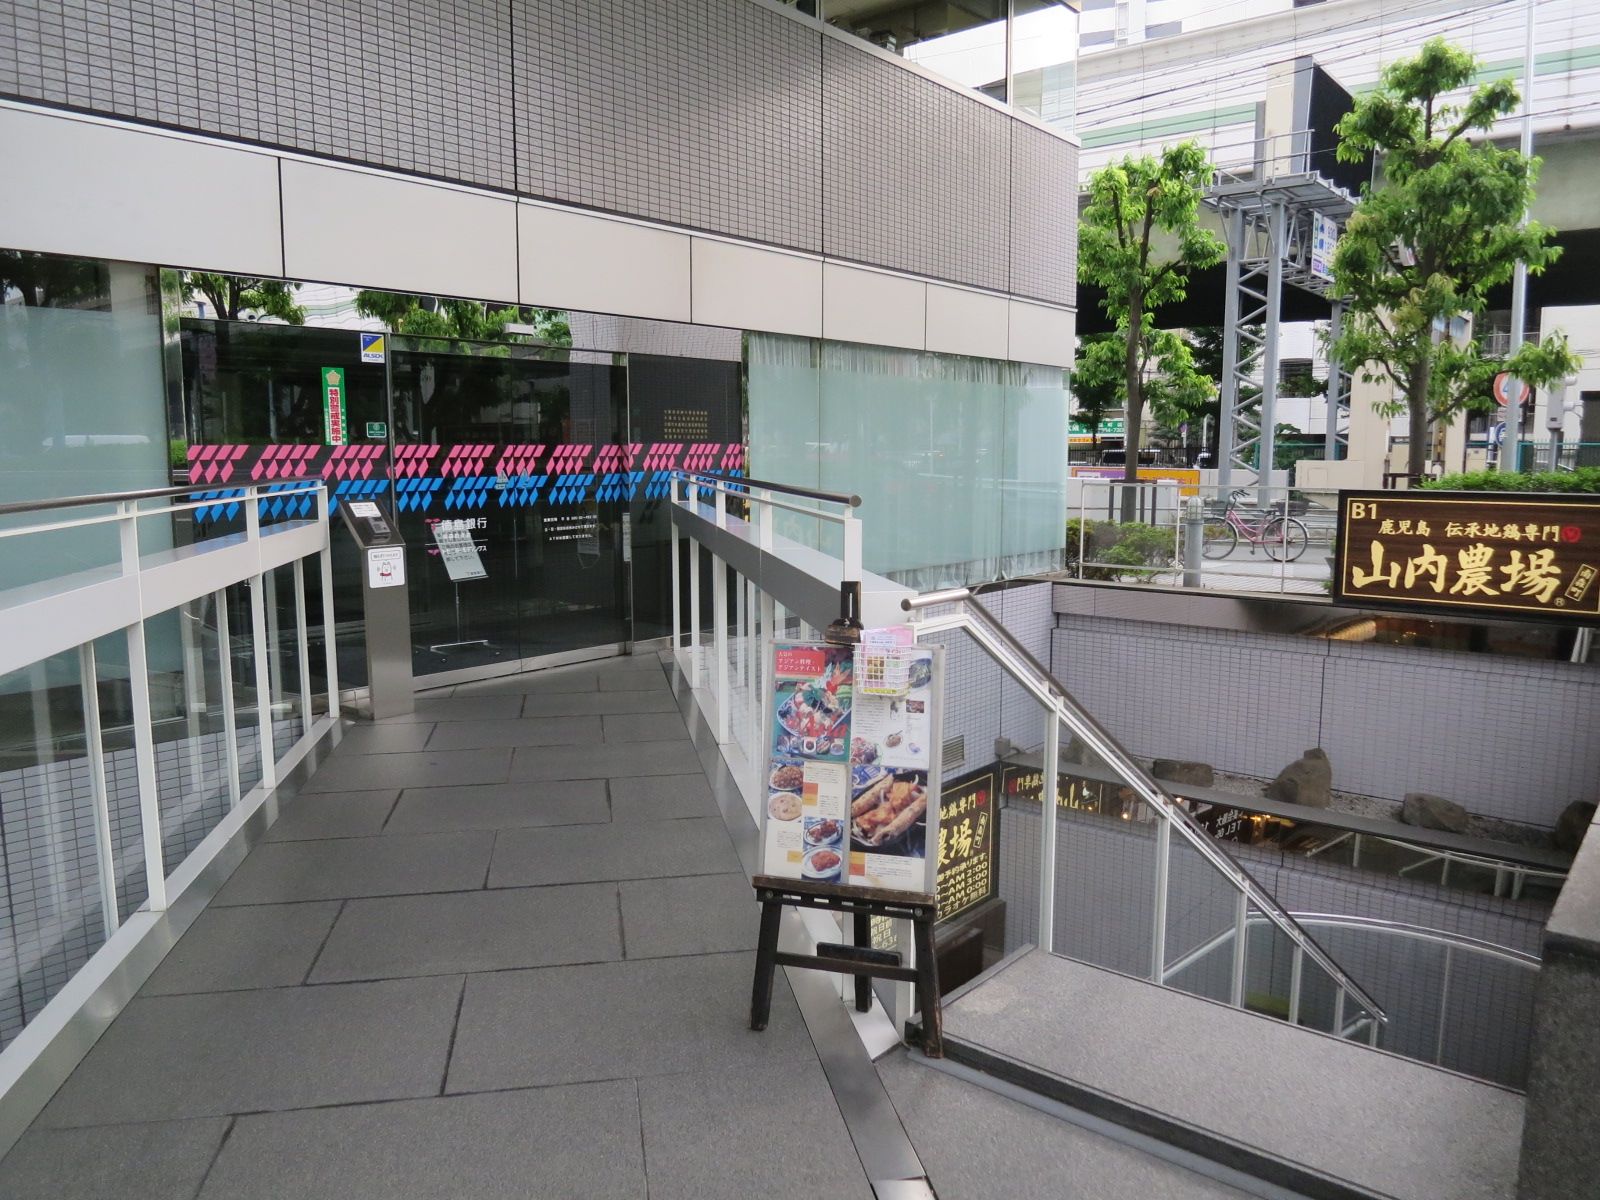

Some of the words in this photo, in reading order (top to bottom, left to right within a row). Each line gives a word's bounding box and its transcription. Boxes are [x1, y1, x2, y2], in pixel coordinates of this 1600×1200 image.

[328, 388, 341, 442] 特別警戒実施中
[1351, 502, 1377, 520] B1
[1378, 518, 1431, 537] 鹿児島
[1444, 521, 1560, 543] 伝承地鶏専門
[1351, 539, 1562, 604] 山内農場
[966, 861, 988, 878] 2:00
[966, 870, 987, 886] 3:00
[966, 879, 987, 895] 0:00
